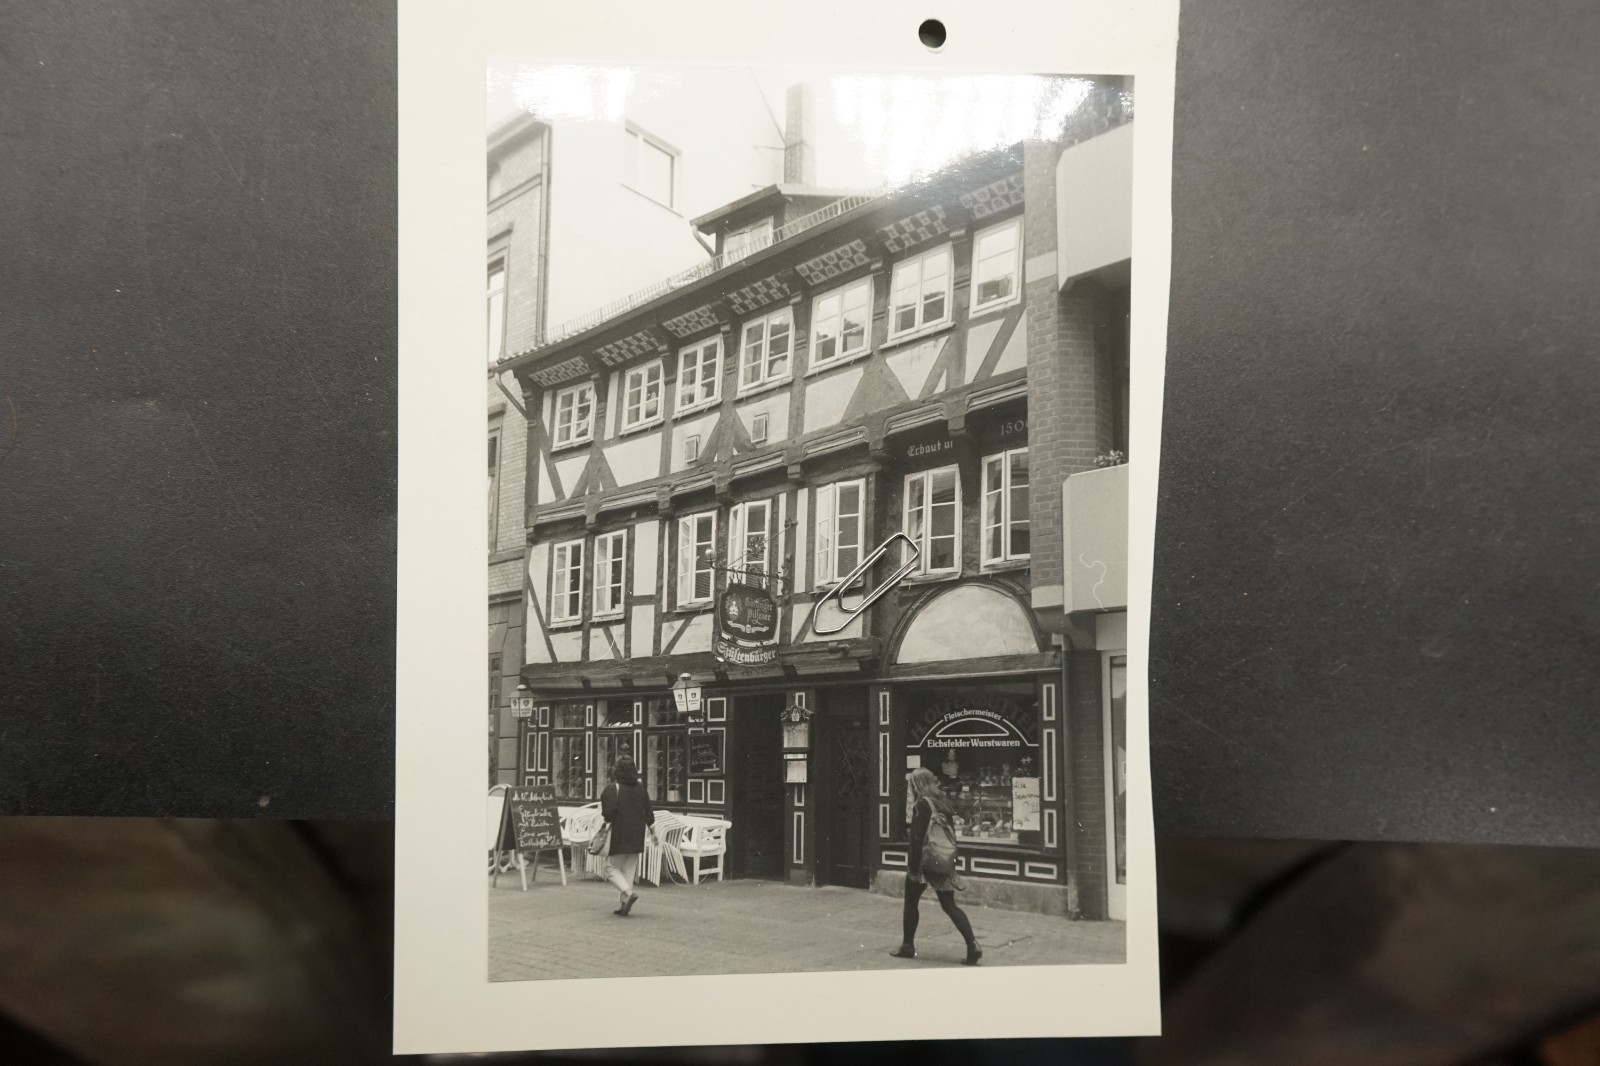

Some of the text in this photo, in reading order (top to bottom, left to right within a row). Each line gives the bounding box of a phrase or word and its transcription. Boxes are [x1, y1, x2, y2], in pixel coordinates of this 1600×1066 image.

[907, 440, 941, 457] Erbaut
[943, 708, 1002, 722] Fleischermeister
[927, 738, 1020, 749] Eichsfelder Wurstwaren
